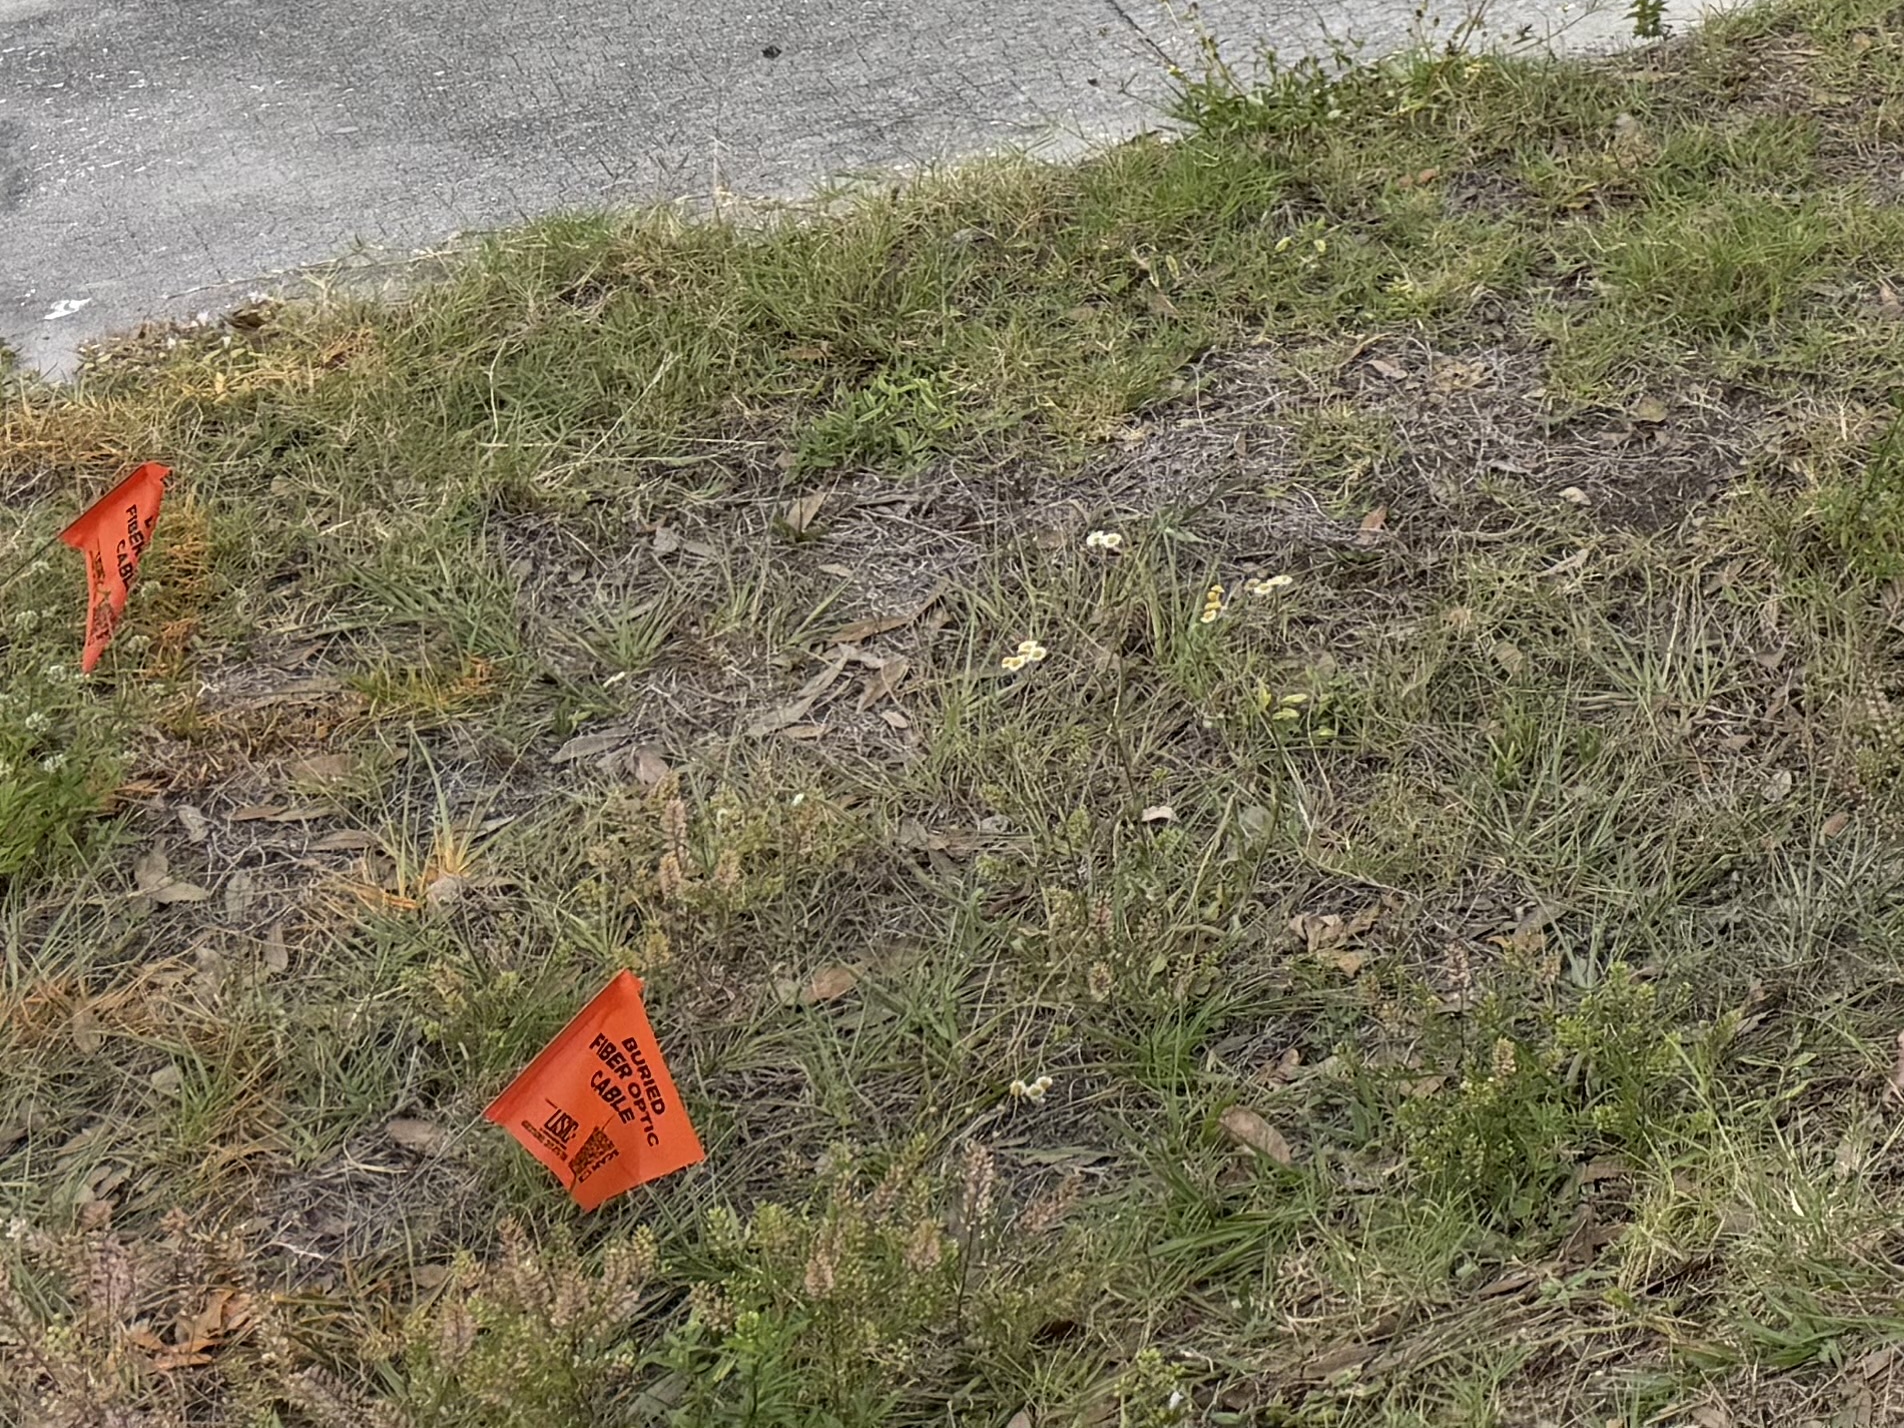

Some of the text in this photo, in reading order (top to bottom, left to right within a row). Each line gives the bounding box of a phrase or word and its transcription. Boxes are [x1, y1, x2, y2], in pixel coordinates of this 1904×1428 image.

[117, 539, 134, 592] CABL
[589, 1032, 659, 1147] FIBER OPTIC
[590, 1070, 635, 1124] CABLE
[621, 1037, 665, 1115] BURIED
